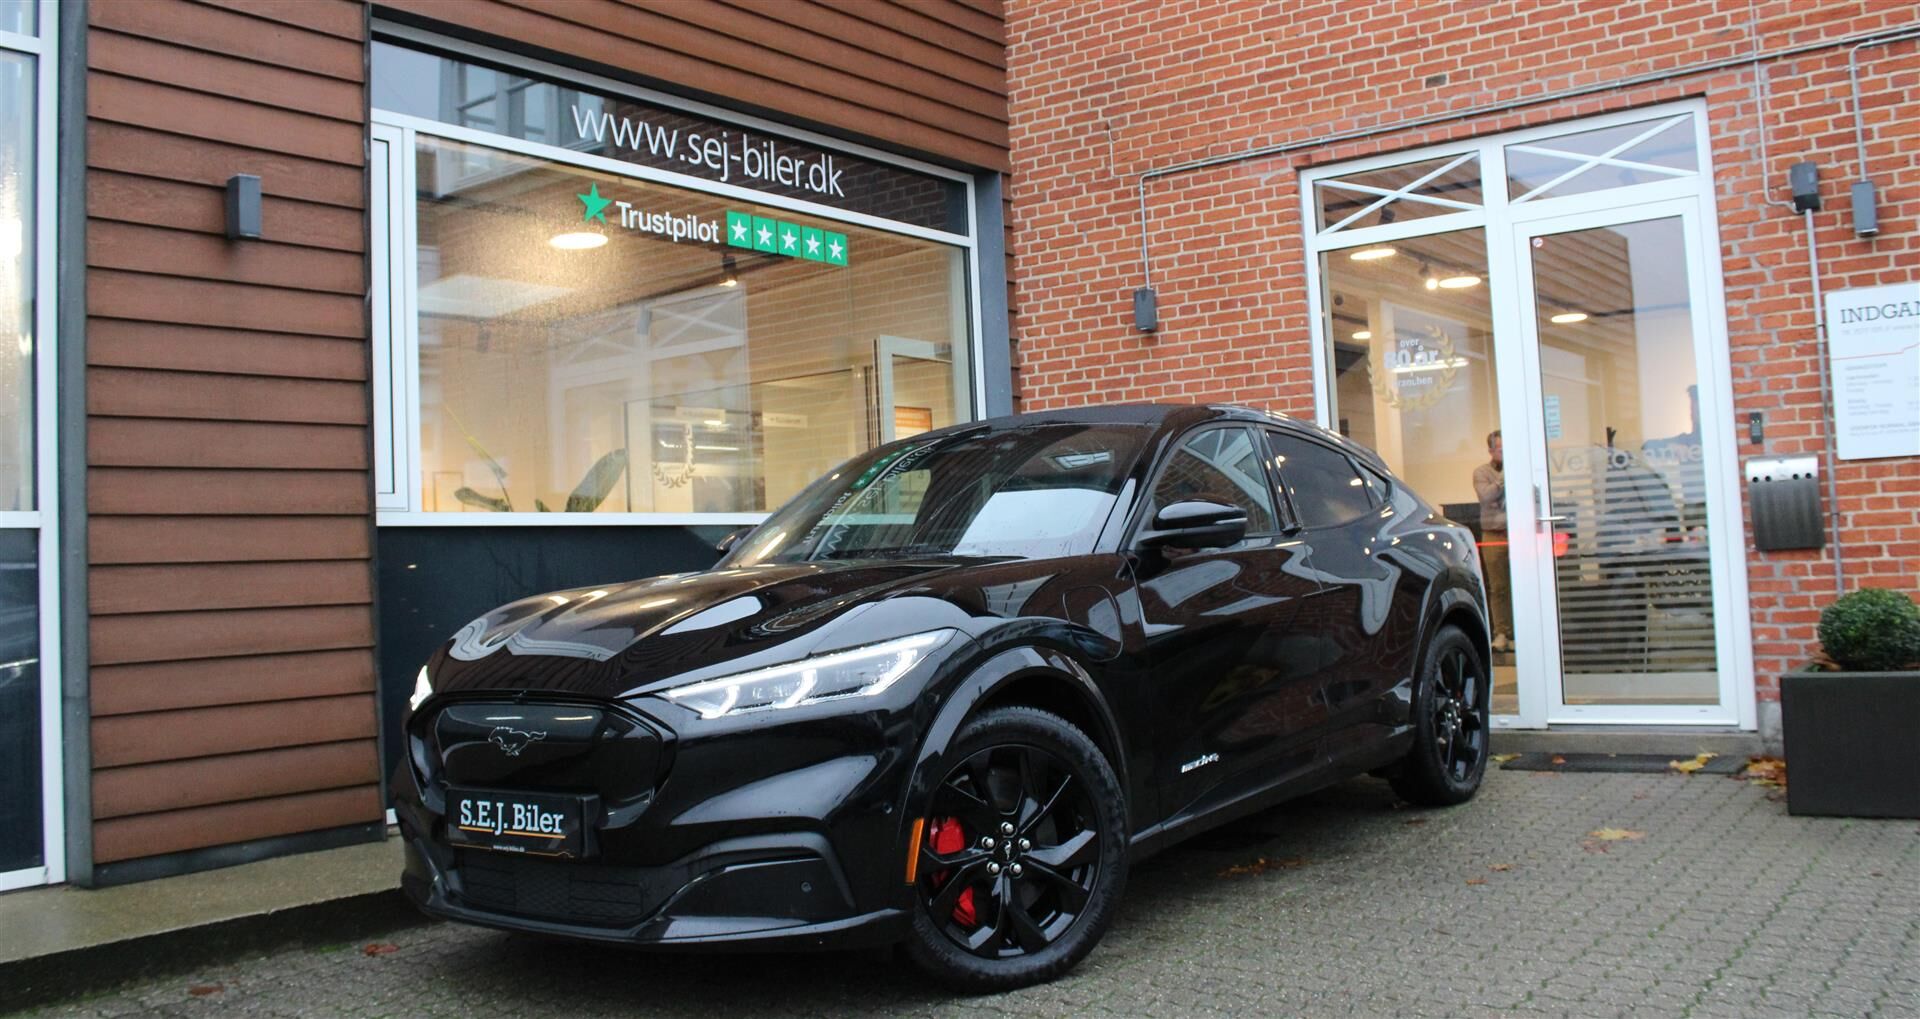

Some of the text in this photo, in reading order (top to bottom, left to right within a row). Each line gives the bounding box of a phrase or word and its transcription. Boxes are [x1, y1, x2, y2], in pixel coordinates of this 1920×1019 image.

[571, 104, 845, 197] www.sej-biler.dk
[615, 200, 720, 243] Trustpilot
[1400, 339, 1419, 348] over
[460, 799, 564, 836] S.E.J. Biler
